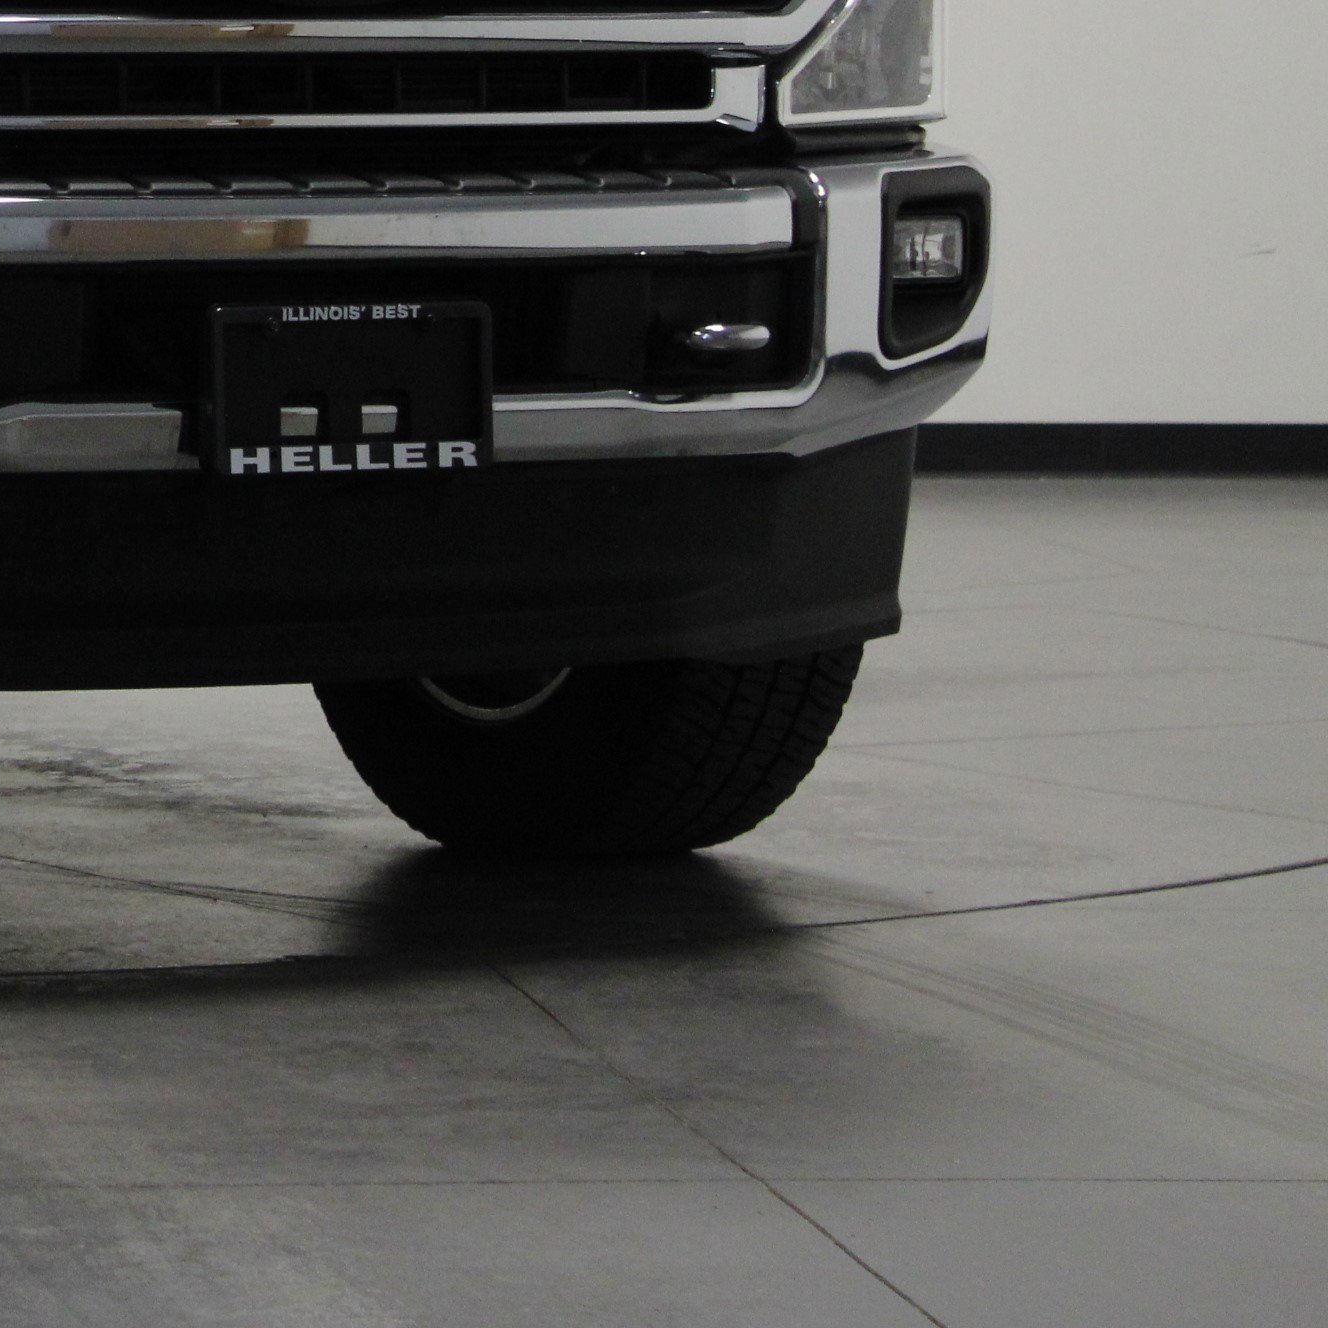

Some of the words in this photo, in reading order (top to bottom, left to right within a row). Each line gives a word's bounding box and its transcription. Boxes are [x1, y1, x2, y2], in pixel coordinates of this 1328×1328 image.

[281, 305, 366, 322] ILLINOIS'
[371, 304, 422, 321] BEST
[229, 440, 479, 475] HELLER
